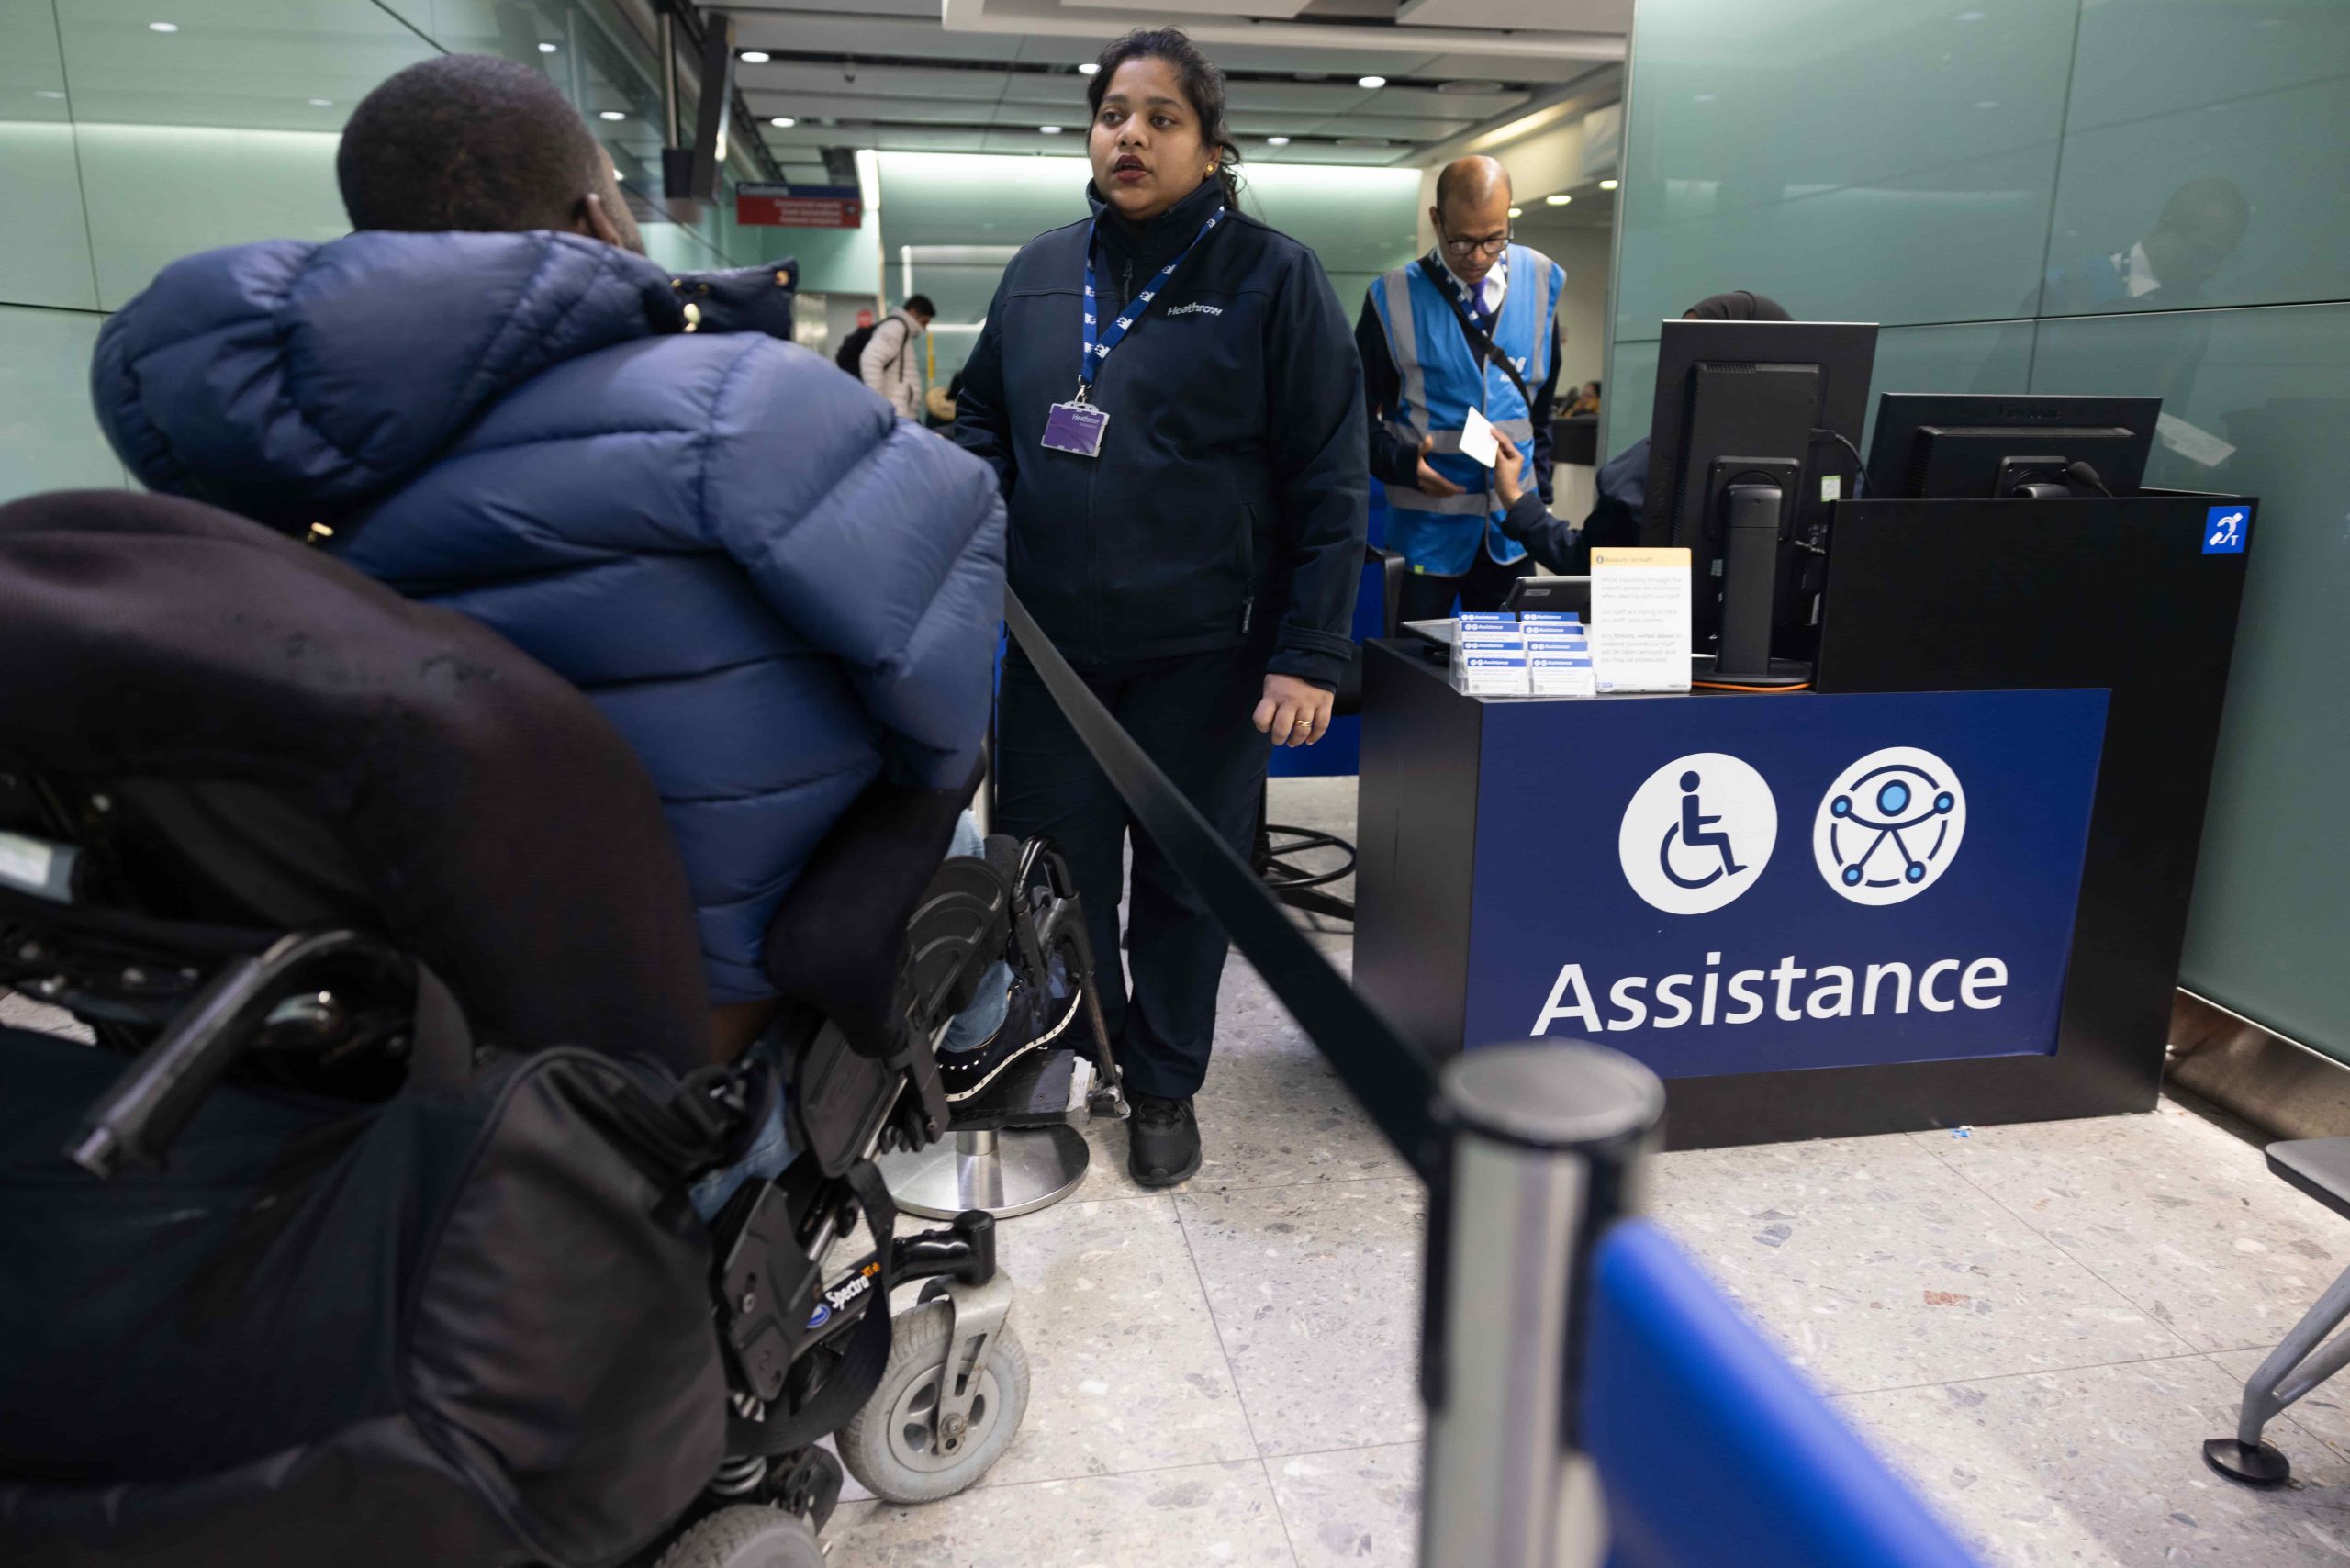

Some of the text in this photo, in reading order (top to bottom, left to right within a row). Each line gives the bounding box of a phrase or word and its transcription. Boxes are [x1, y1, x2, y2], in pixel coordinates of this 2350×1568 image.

[1167, 301, 1223, 316] Heathrow
[1071, 411, 1101, 424] Heathrow
[2231, 534, 2240, 546] T
[1530, 952, 2009, 1036] Assistance
[824, 1274, 871, 1311] Spectra
